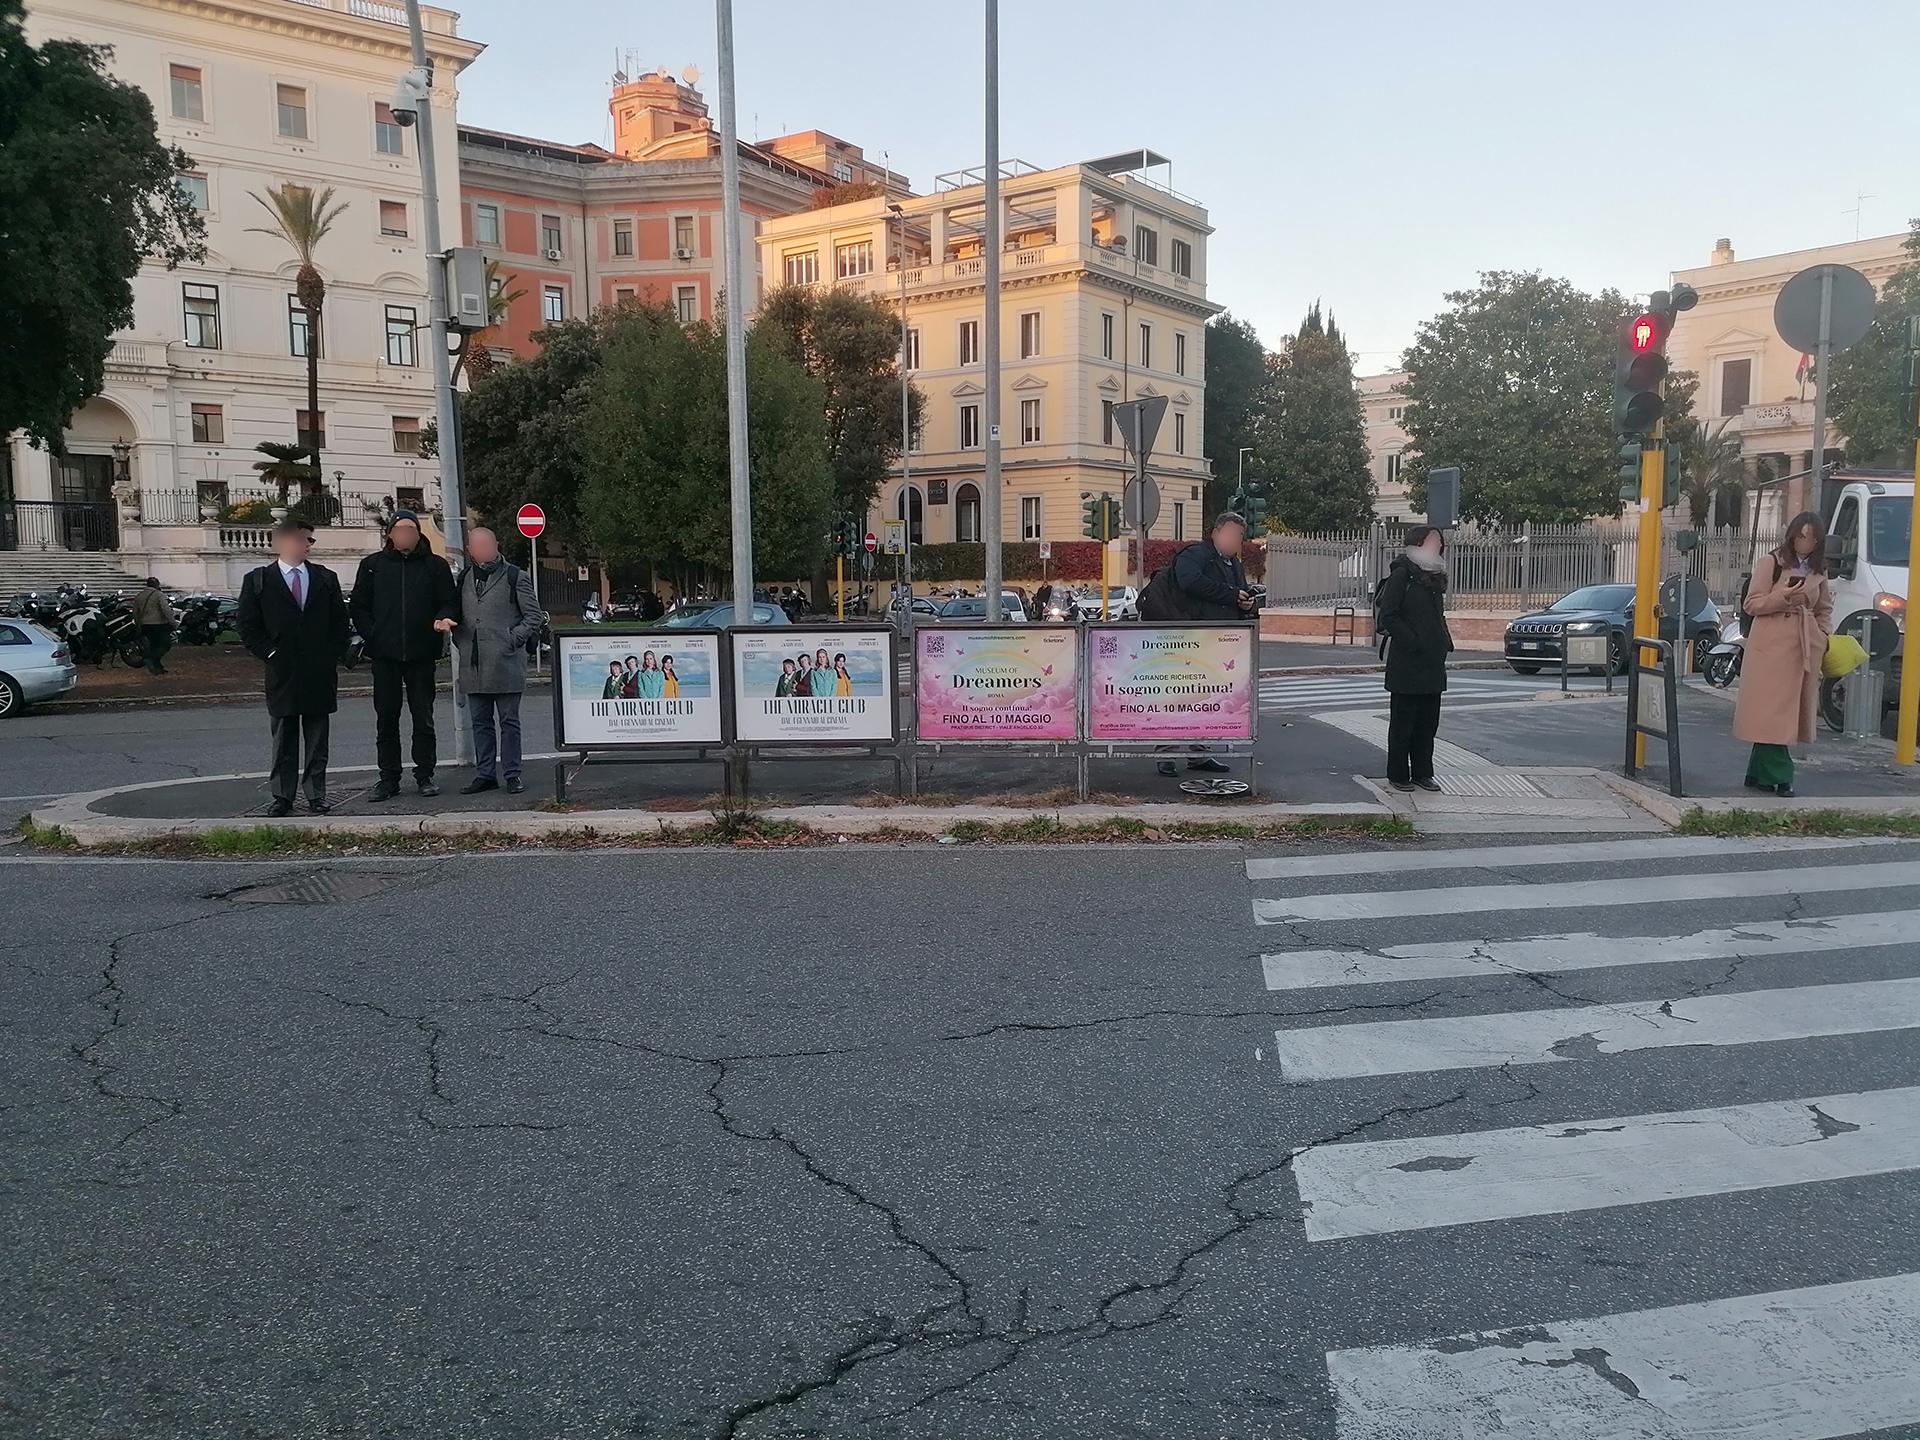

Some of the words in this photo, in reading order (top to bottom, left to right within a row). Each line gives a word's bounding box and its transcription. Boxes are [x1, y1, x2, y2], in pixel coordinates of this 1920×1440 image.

[1142, 640, 1200, 650] Dreamers
[953, 674, 1042, 688] Dreamers
[1105, 684, 1114, 695] Il
[1118, 685, 1161, 697] sogno
[1165, 682, 1233, 695] continua!
[1120, 704, 1145, 713] FINO
[1147, 704, 1161, 712] AL
[1164, 704, 1174, 712] 10
[1178, 703, 1221, 712] MAGGIO
[943, 715, 969, 724] FINO
[972, 715, 987, 723] AL
[990, 714, 1002, 723] 10
[1005, 714, 1052, 723] MAGGIO
